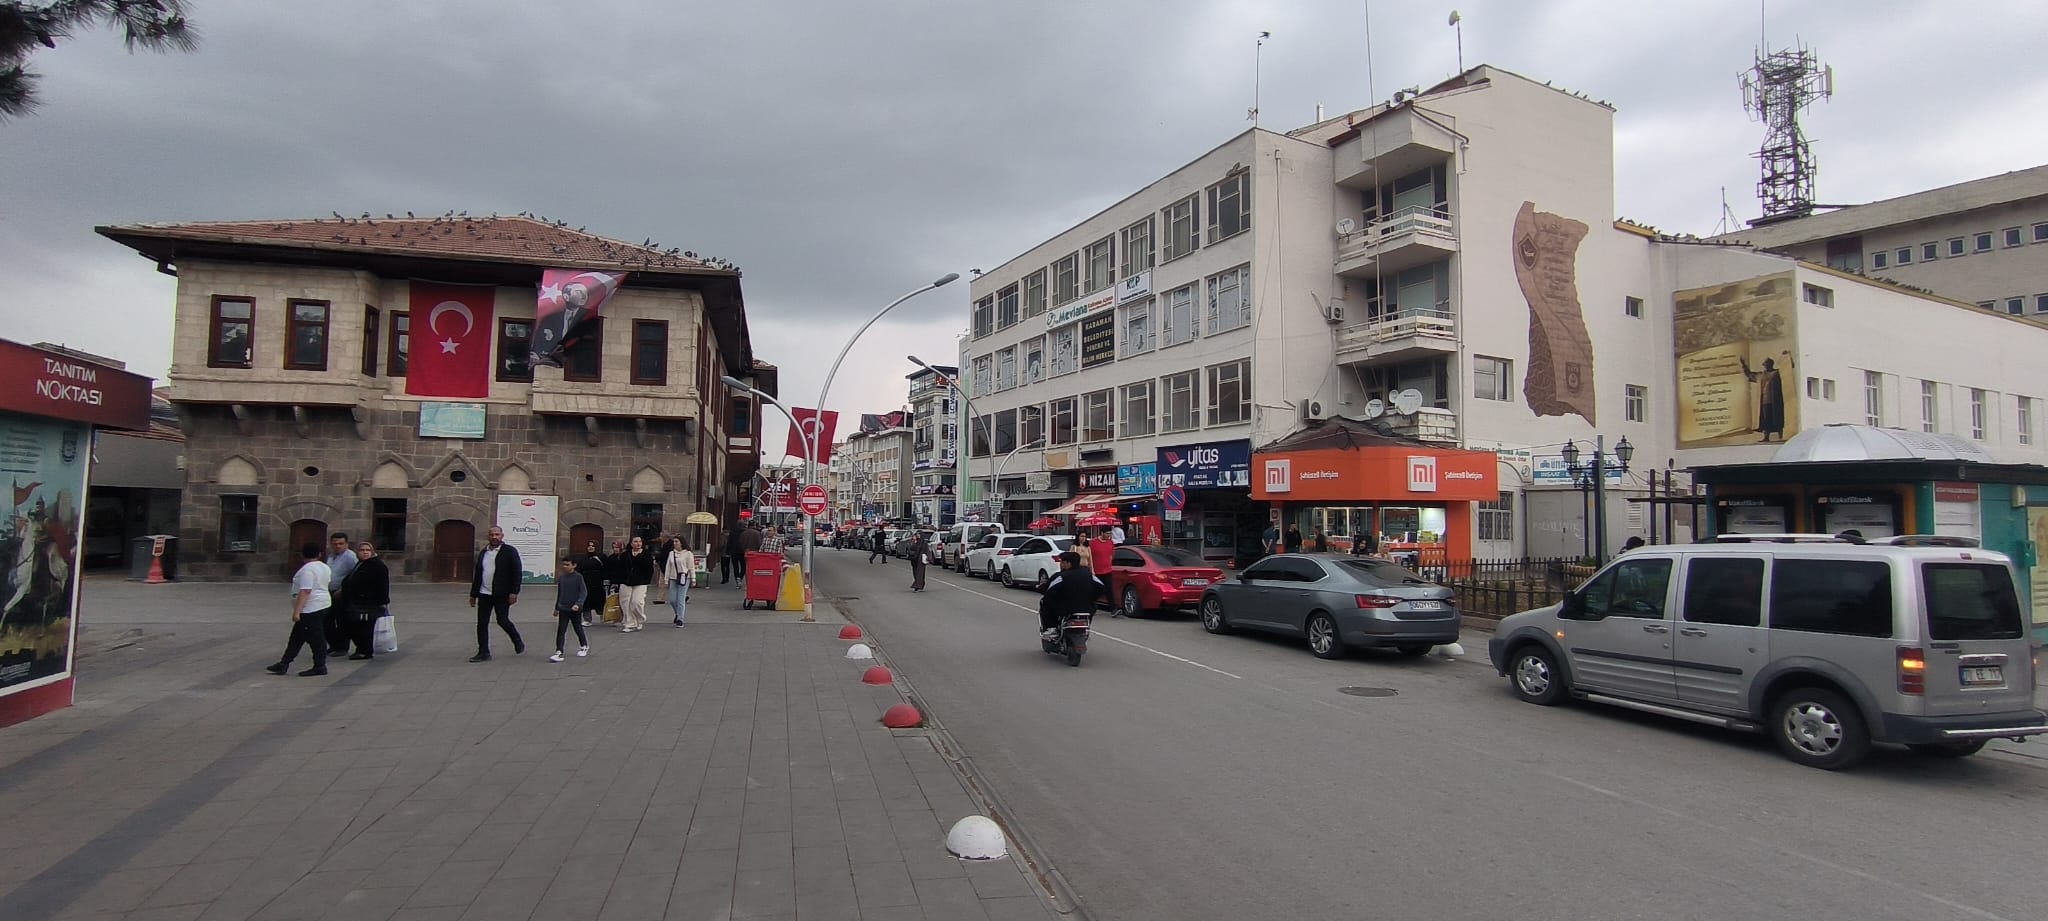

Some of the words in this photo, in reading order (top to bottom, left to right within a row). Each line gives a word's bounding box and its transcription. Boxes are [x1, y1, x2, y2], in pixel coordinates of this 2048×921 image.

[1086, 316, 1112, 330] KARAMAN
[44, 358, 97, 384] TANITIM
[37, 379, 103, 406] NOKTASI
[1089, 472, 1116, 487] NİZAM
